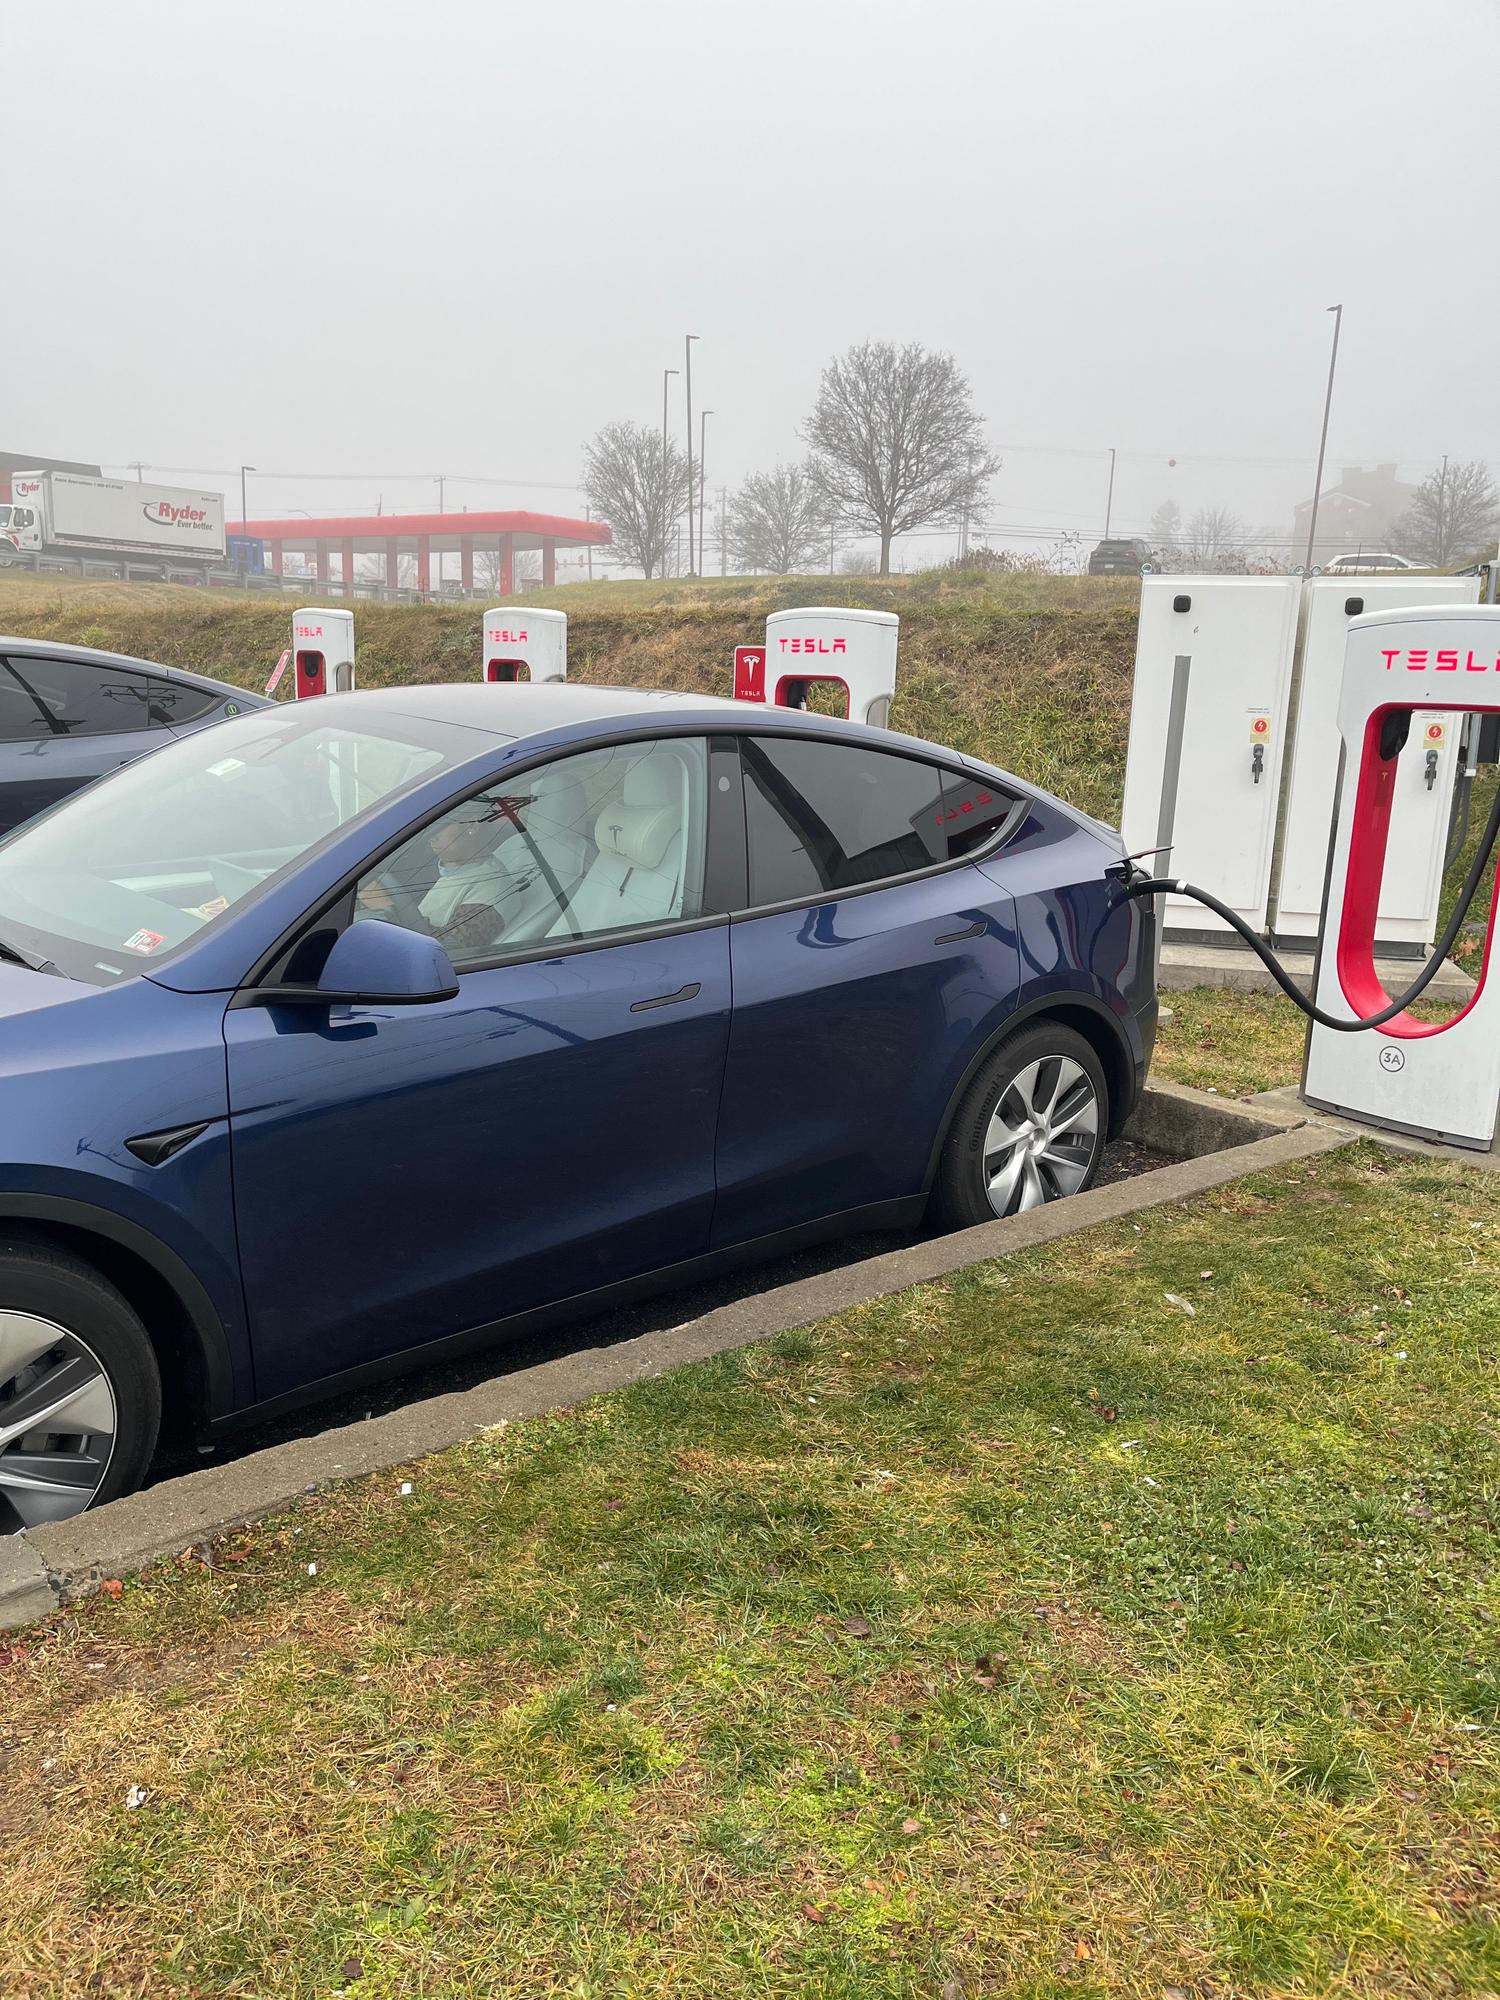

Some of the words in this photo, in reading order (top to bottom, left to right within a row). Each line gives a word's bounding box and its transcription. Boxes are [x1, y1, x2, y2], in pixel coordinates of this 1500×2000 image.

[22, 482, 40, 493] Ryder
[158, 502, 206, 521] Ryder
[177, 520, 191, 528] Ever
[295, 627, 322, 636] TESLA
[489, 631, 527, 642] TESLA
[779, 638, 846, 653] TESLA
[1381, 650, 1500, 672] TESL
[1384, 1052, 1401, 1066] 3A
[969, 1080, 1000, 1153] Continental
